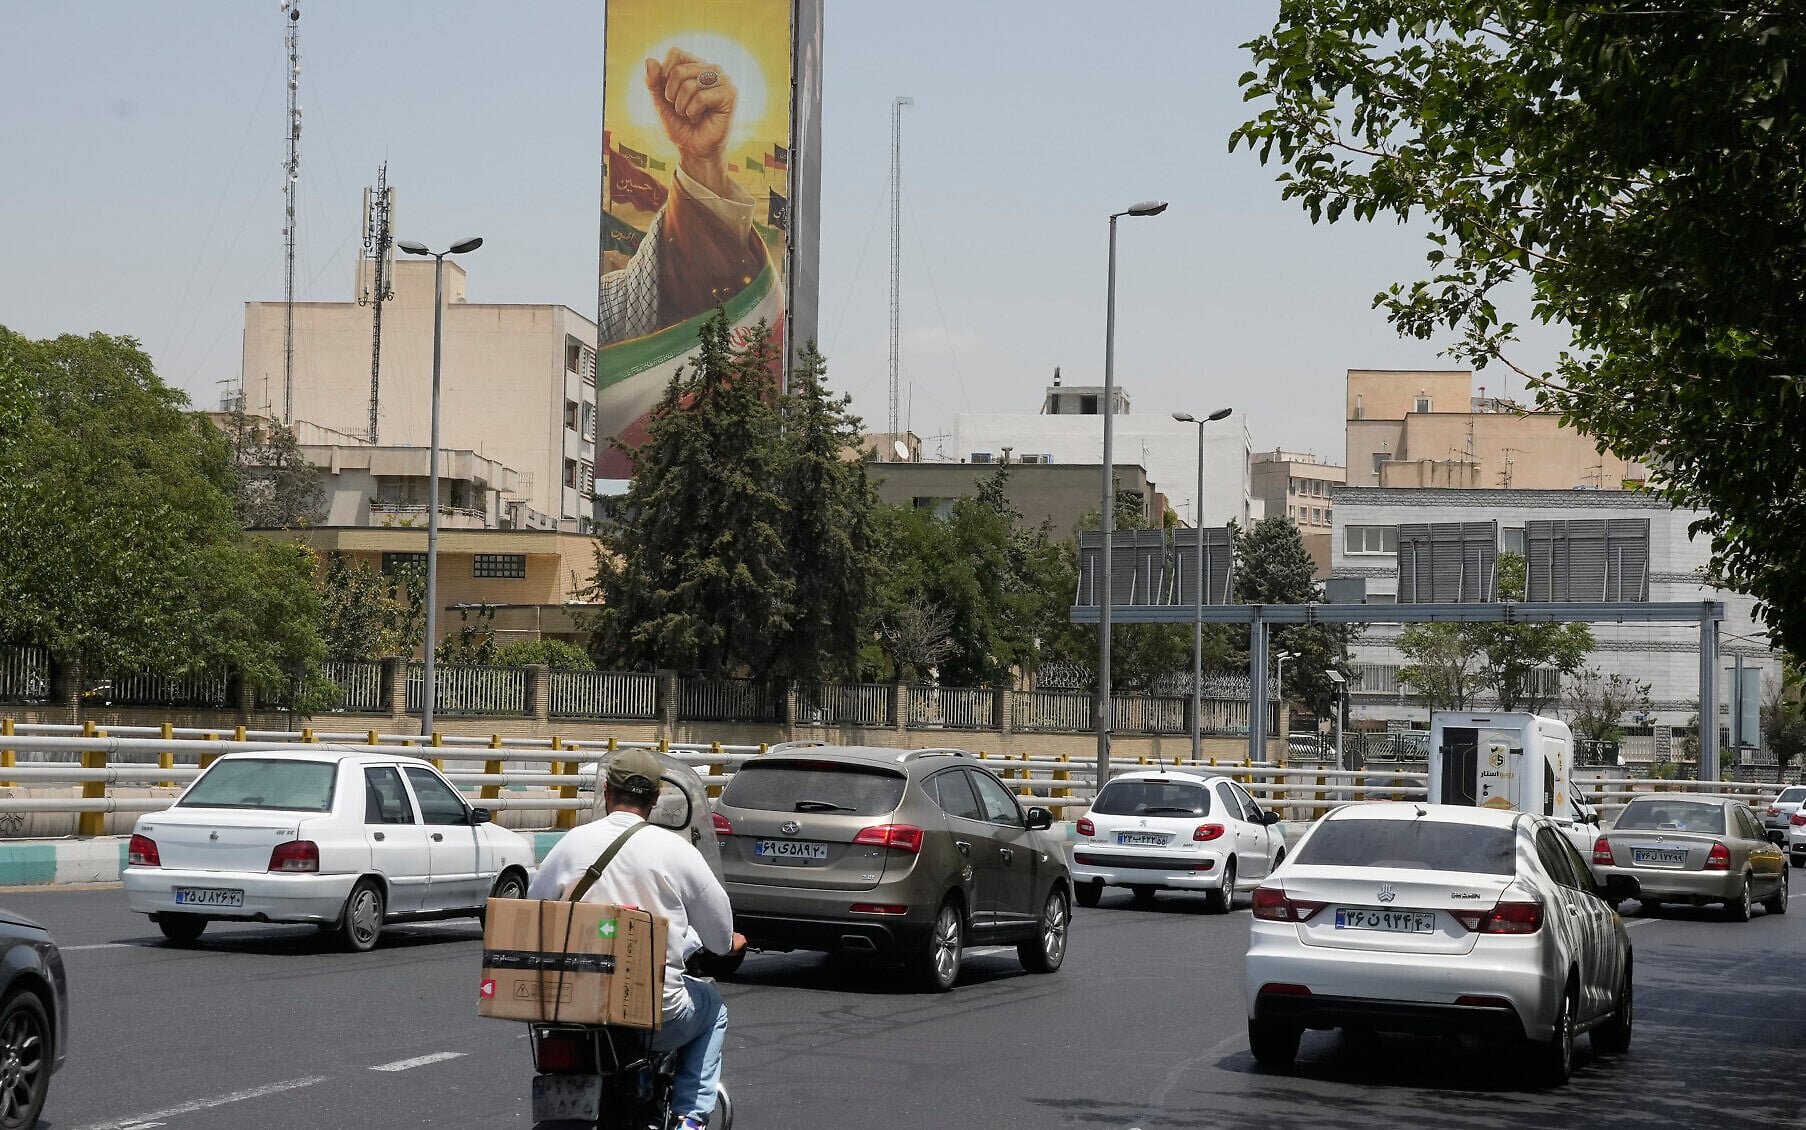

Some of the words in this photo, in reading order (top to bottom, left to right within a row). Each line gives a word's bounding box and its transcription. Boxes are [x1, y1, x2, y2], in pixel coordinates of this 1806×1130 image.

[616, 177, 653, 193] حسین
[1480, 770, 1499, 778] استار
[1346, 911, 1364, 926] ۳۶
[1384, 912, 1412, 929] ۹۳۴
[1415, 917, 1431, 931] ۴۰
